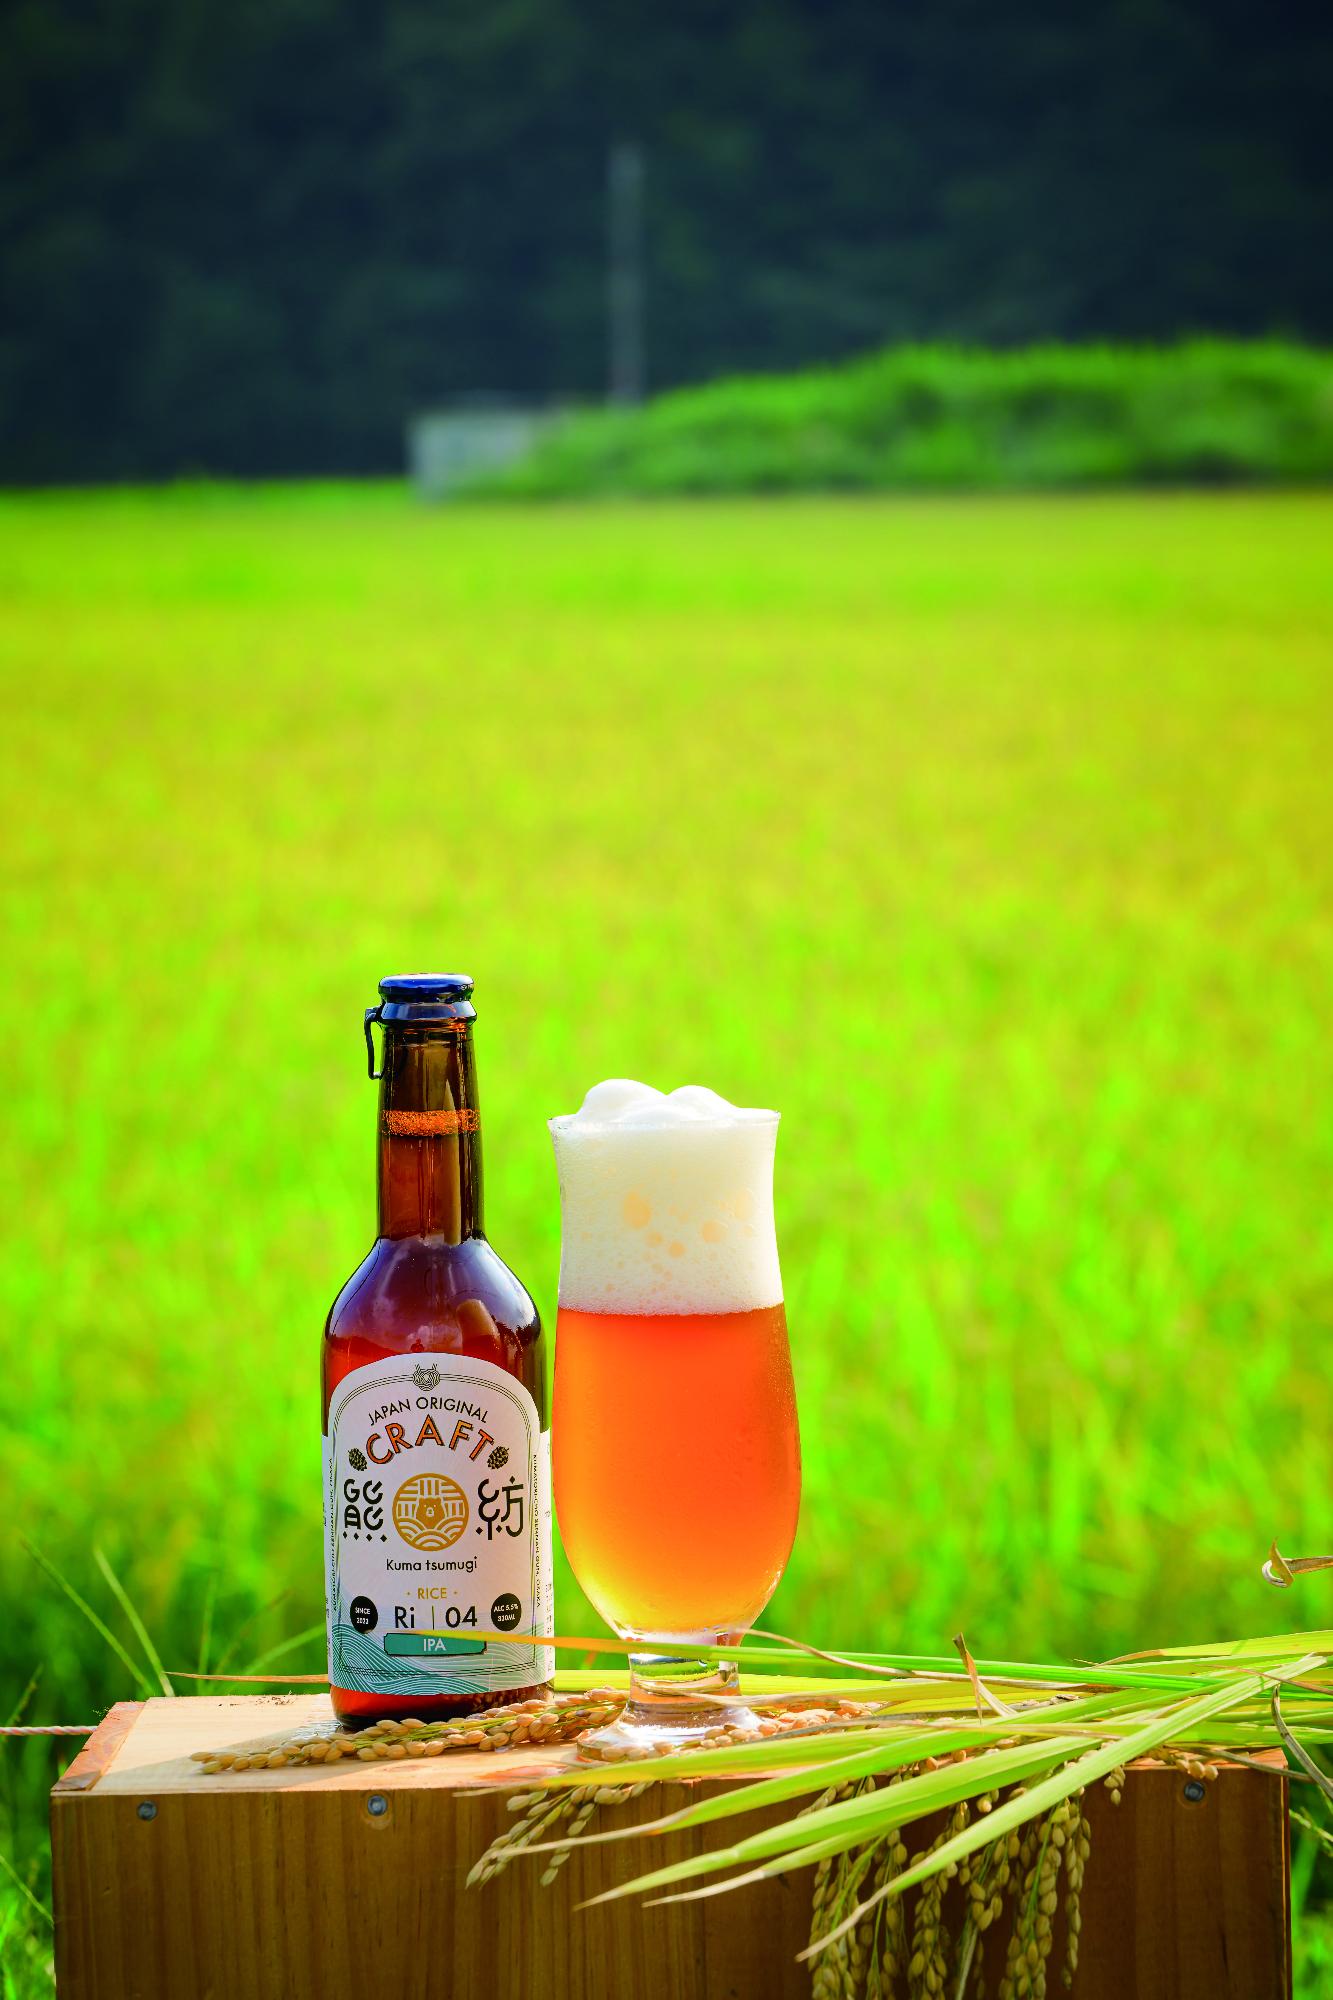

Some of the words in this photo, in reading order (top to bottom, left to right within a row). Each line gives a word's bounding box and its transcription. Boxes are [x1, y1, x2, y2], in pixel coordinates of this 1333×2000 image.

[369, 1399, 411, 1426] JAPAN
[416, 1397, 488, 1423] ORIGINAL
[366, 1413, 494, 1464] CRAFT
[386, 1558, 421, 1571] Kuma
[426, 1555, 477, 1573] tsumugi
[417, 1587, 447, 1599] RICE
[355, 1606, 371, 1615] SINCE
[394, 1605, 415, 1628] Ri
[445, 1606, 478, 1628] 04
[423, 1638, 446, 1652] IPA
